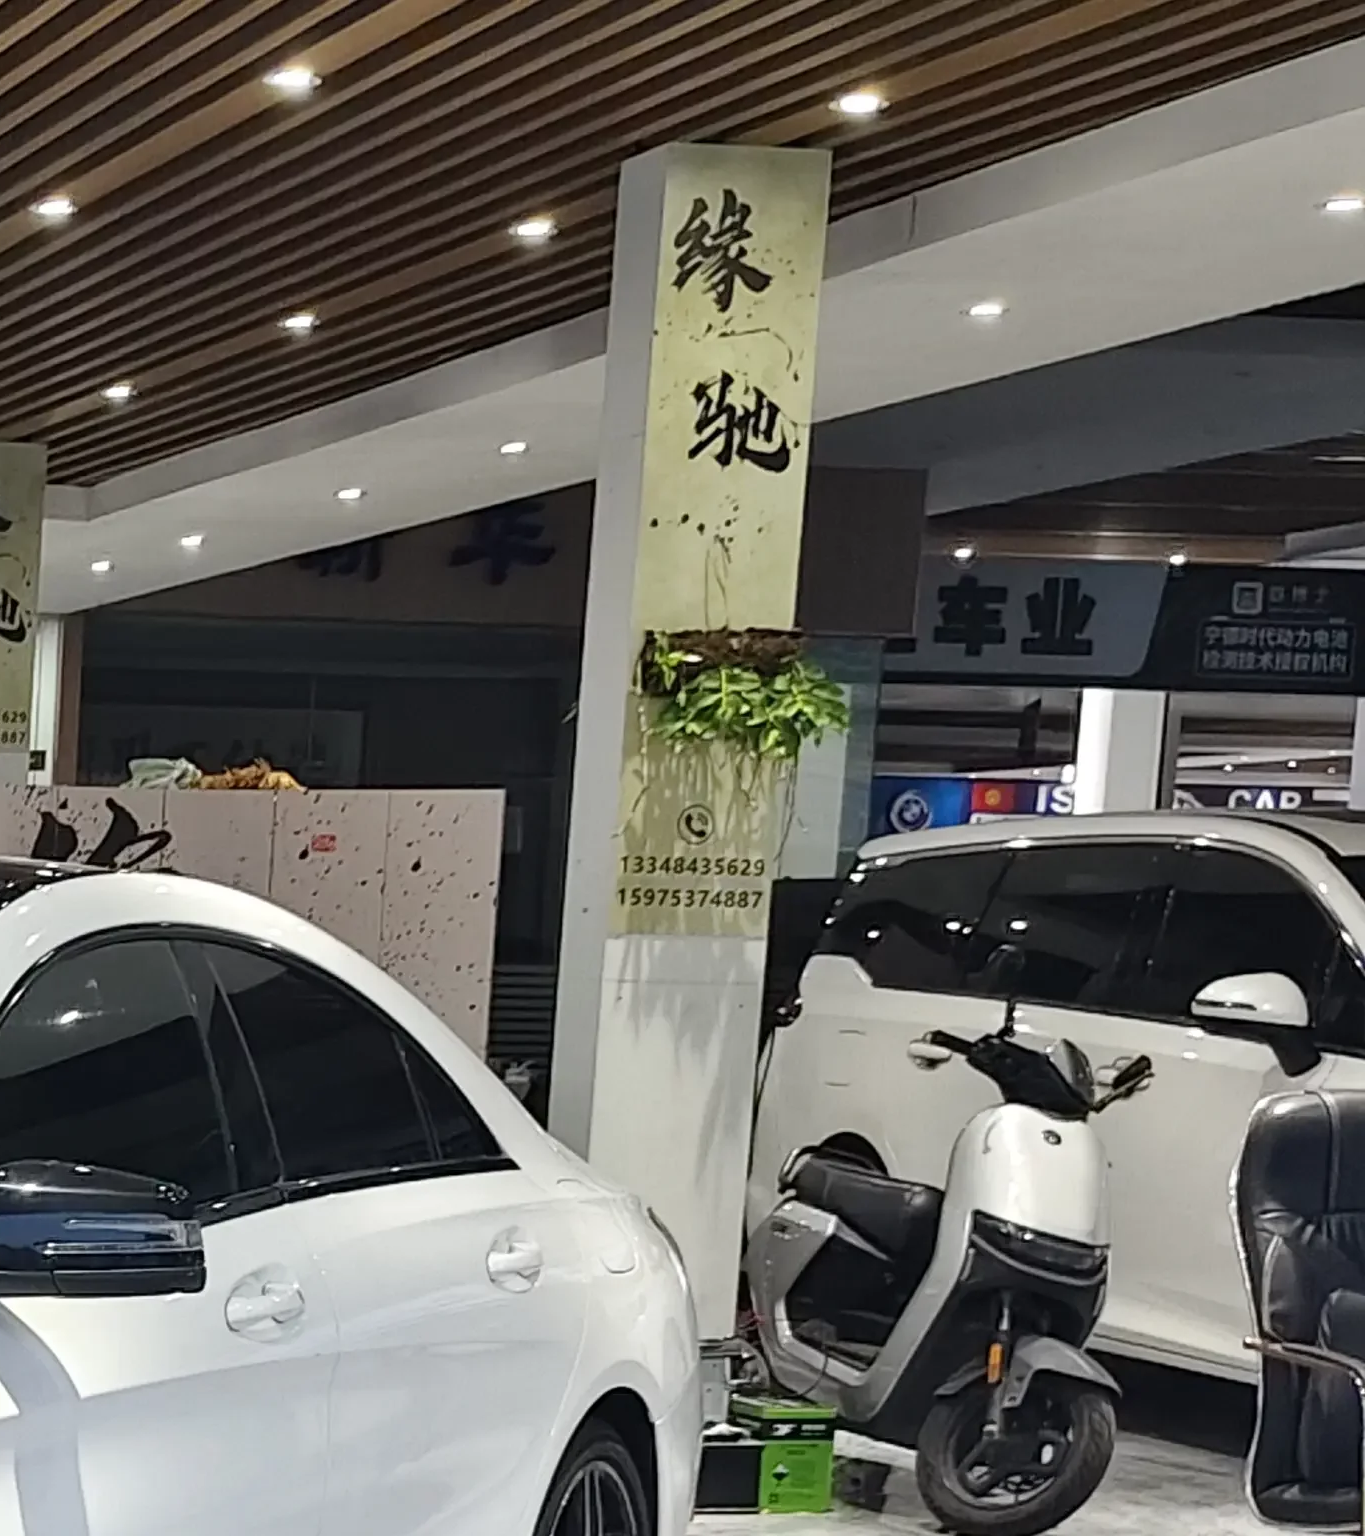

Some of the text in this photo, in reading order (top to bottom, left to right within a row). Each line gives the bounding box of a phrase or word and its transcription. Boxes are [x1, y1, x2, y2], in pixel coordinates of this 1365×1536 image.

[671, 188, 791, 473] 缘驰
[882, 574, 1097, 657] 车业
[620, 855, 765, 877] 13348435629
[617, 887, 764, 909] 15975374887
